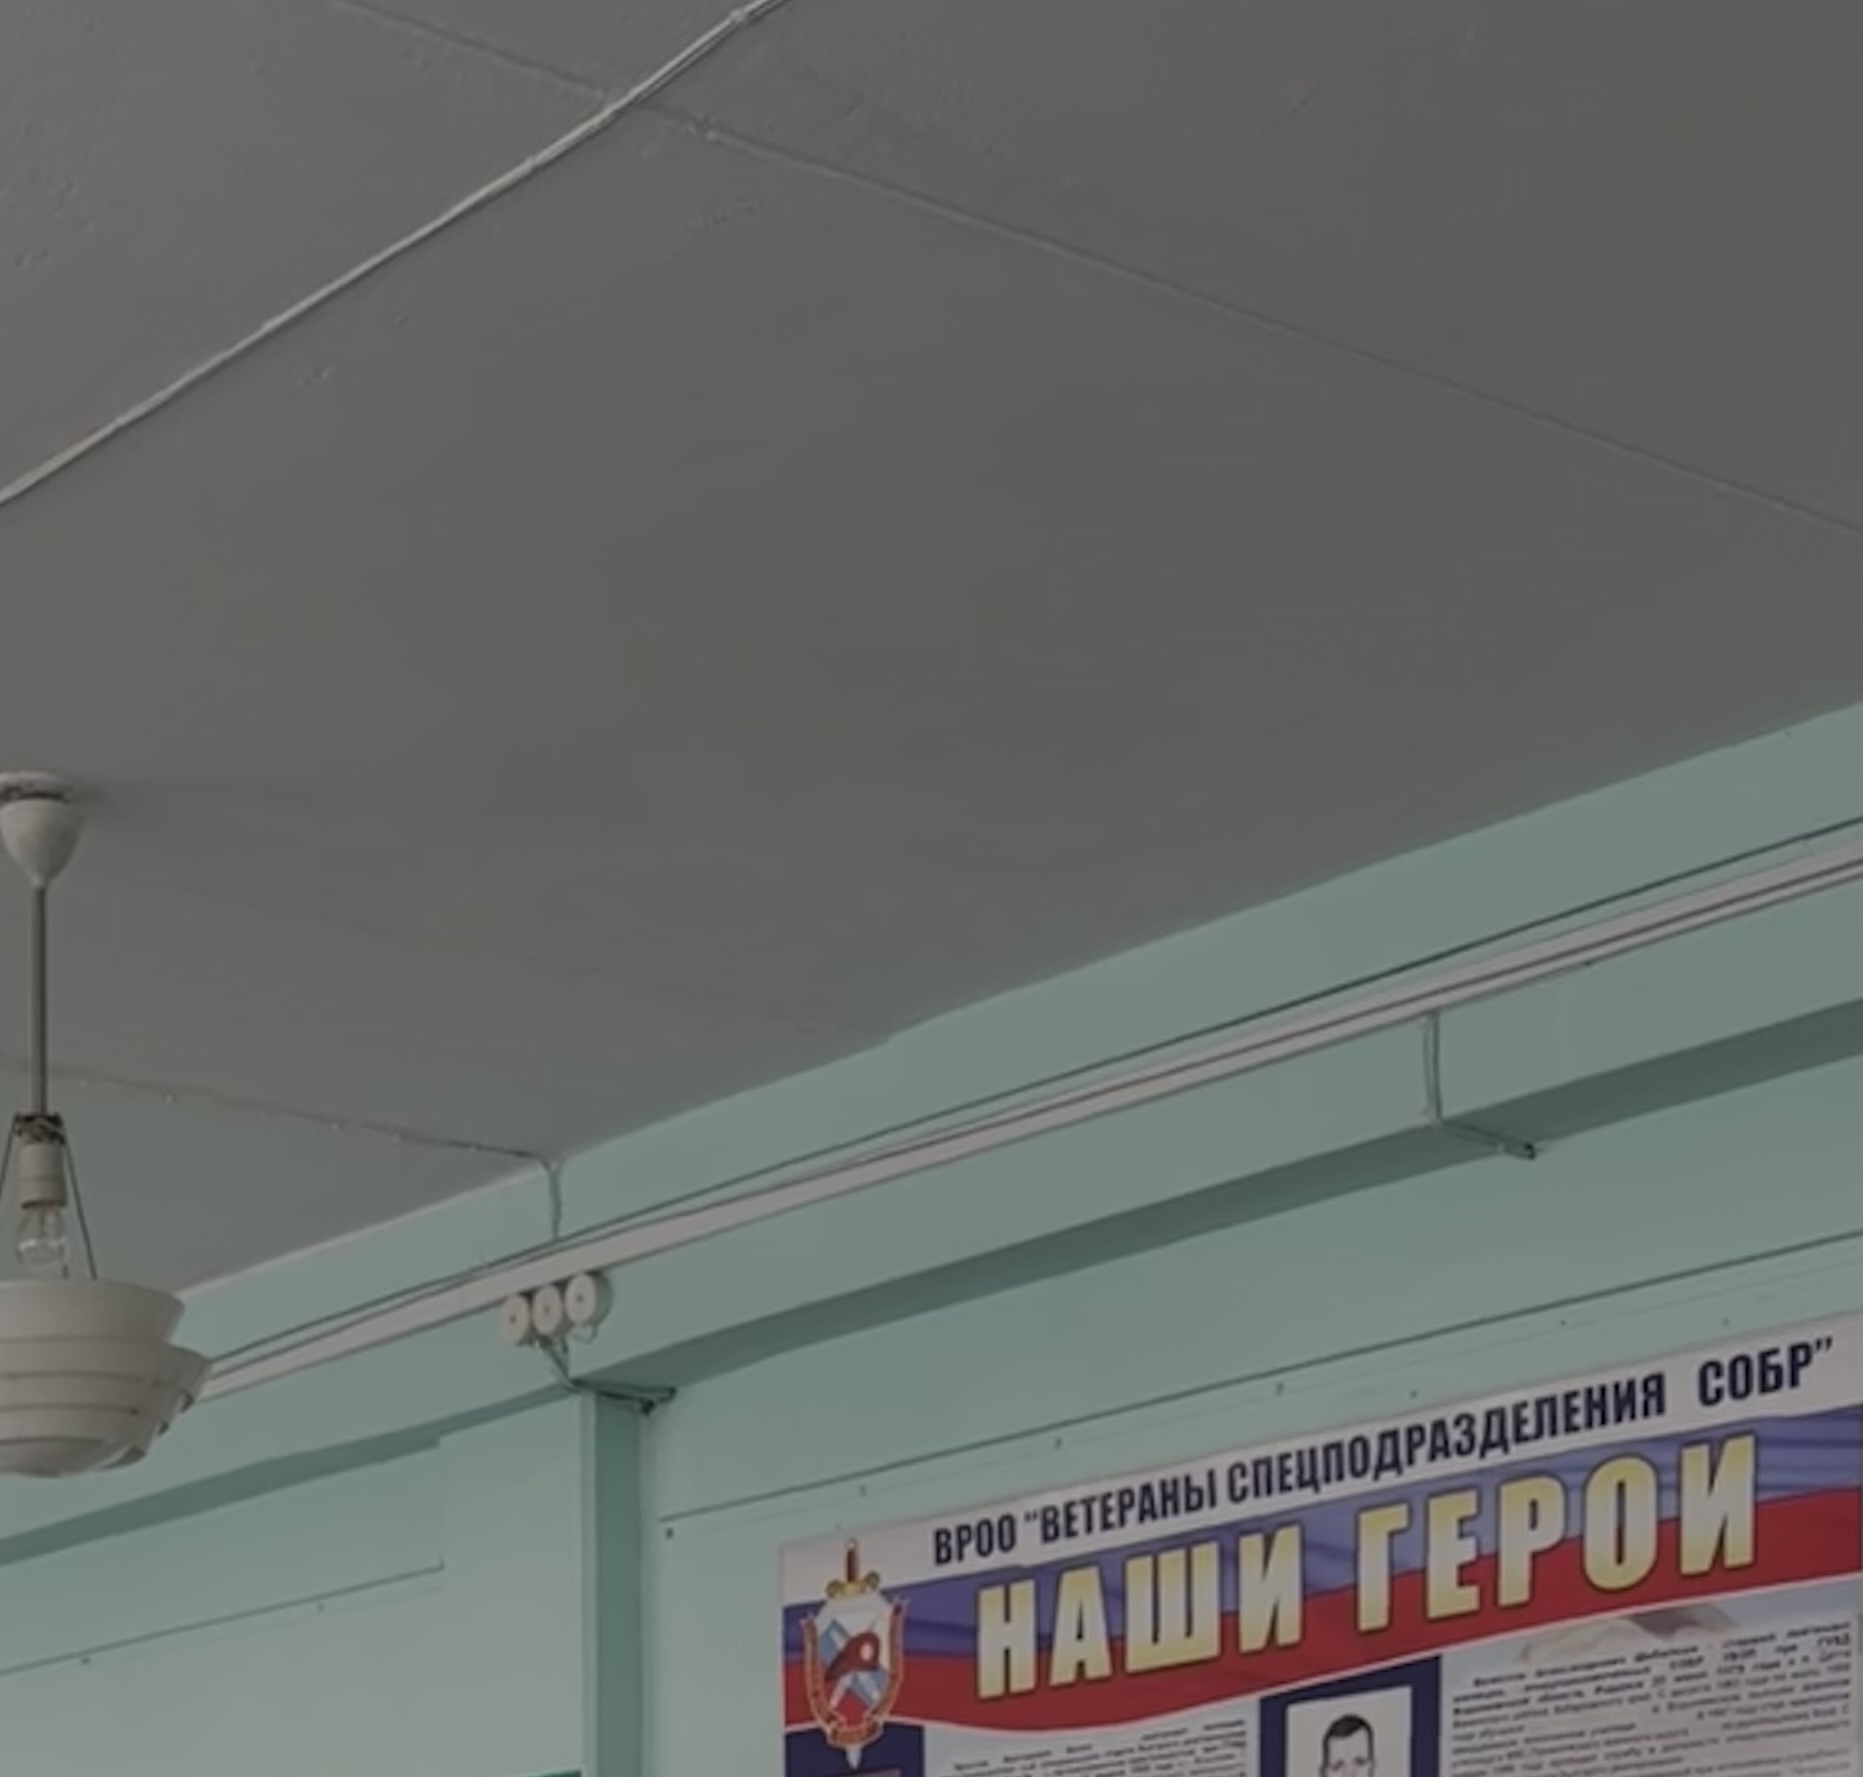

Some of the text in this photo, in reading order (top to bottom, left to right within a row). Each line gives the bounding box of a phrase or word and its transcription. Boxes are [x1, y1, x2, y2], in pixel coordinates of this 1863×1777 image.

[933, 1516, 1017, 1567] ВРОО
[1227, 1371, 1667, 1502] СПЕЦПОДРАЗДЕЛЕНИЯ
[976, 1433, 1758, 1700] НАШИ ГЕРОИ
